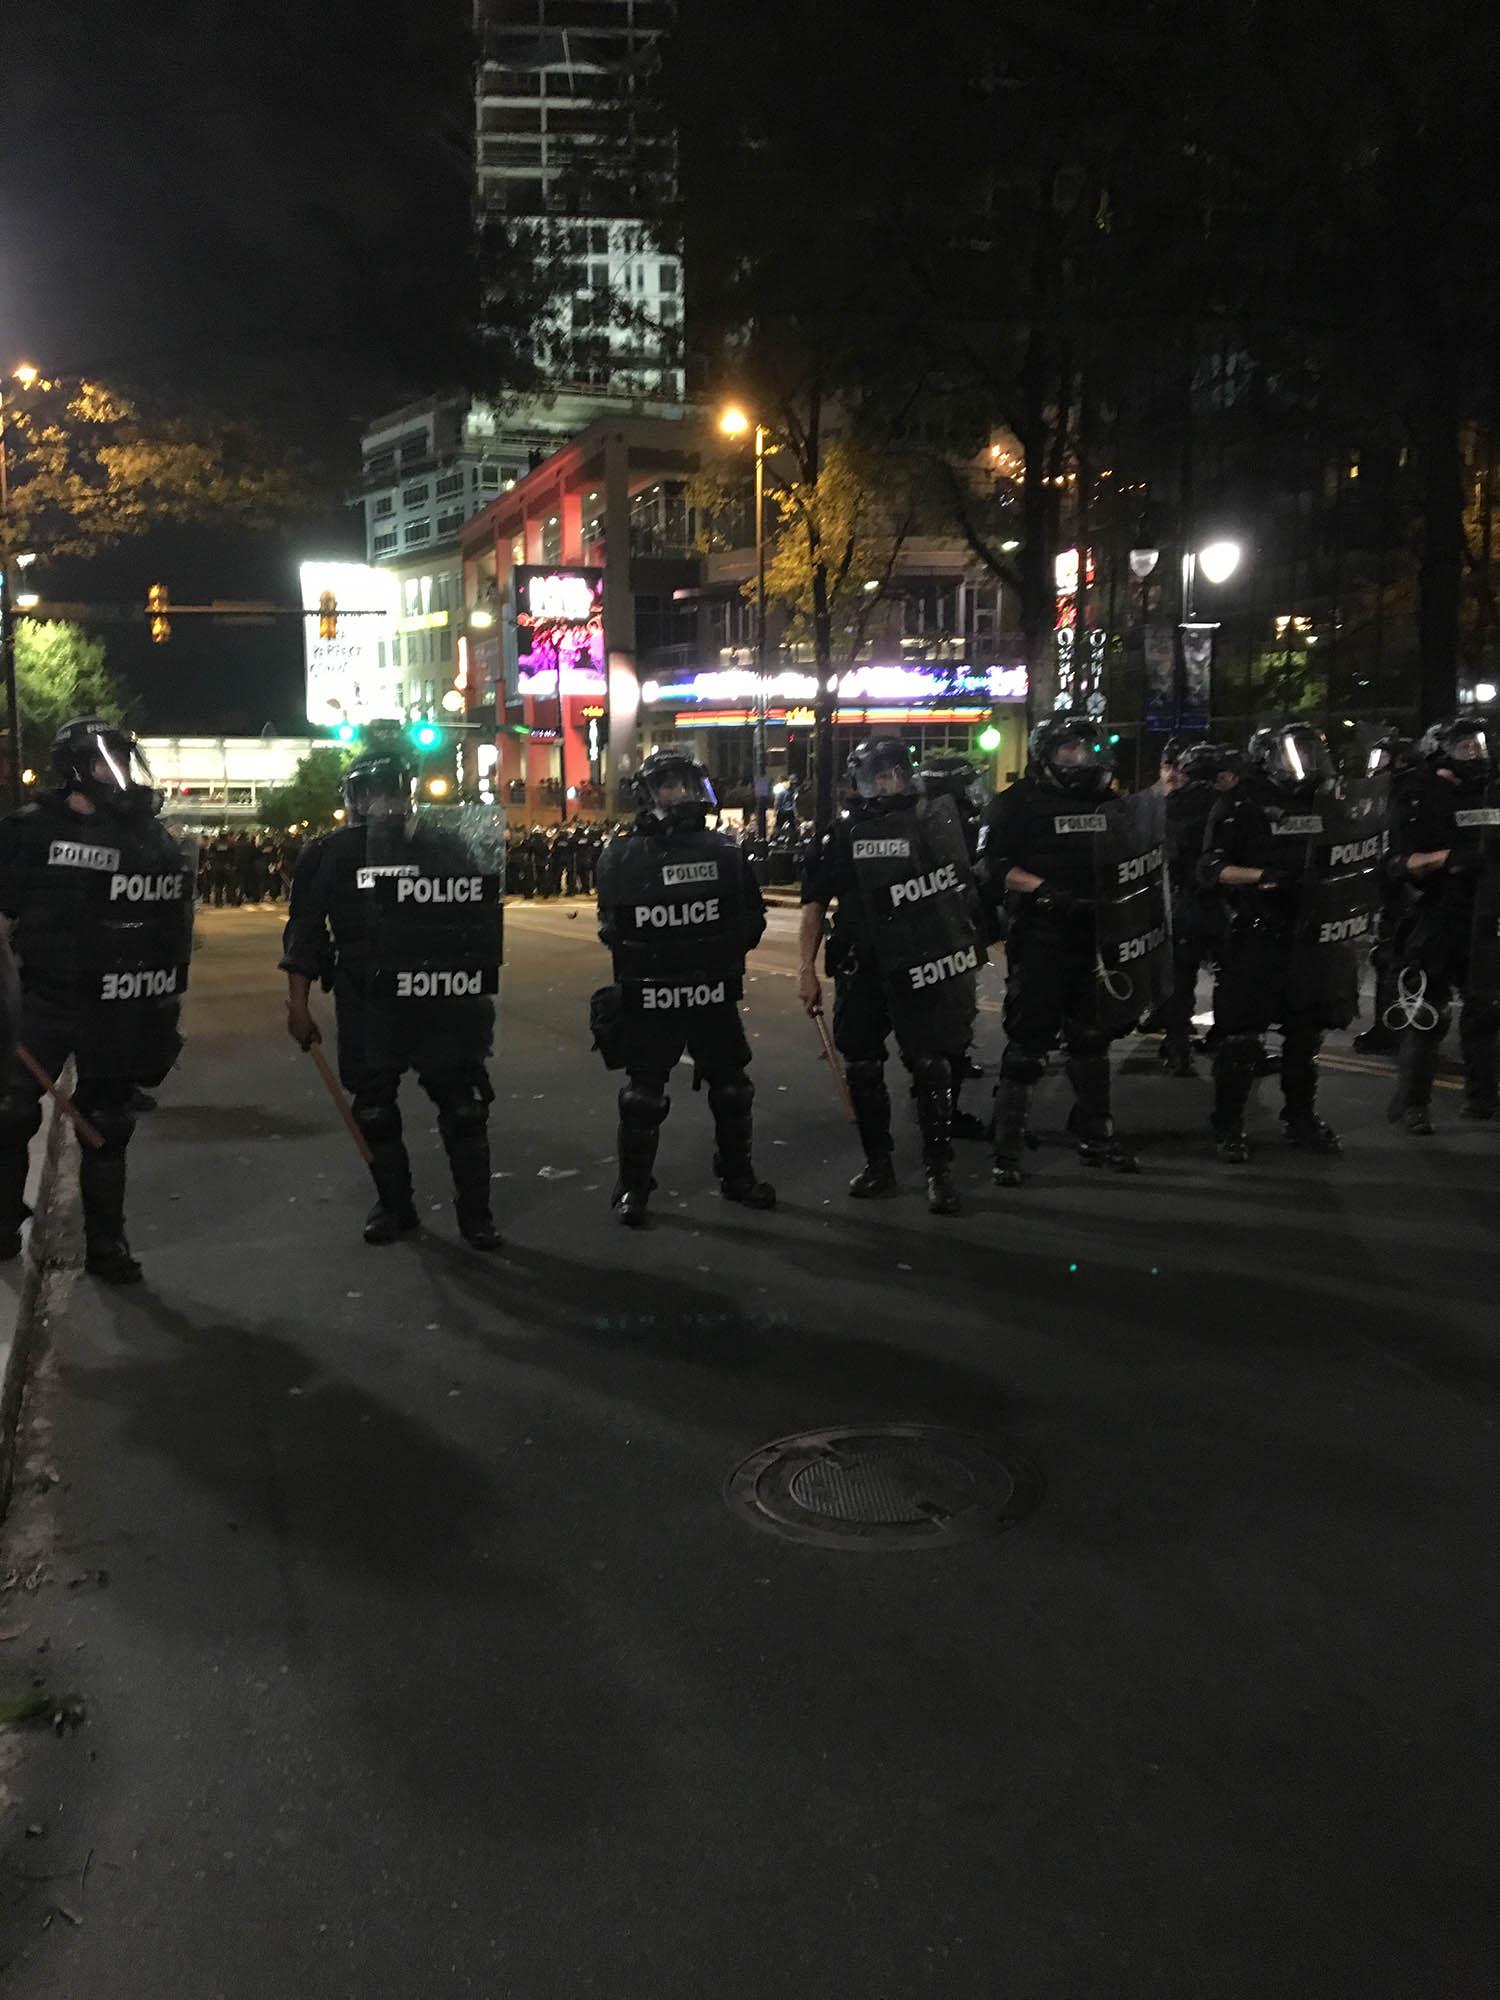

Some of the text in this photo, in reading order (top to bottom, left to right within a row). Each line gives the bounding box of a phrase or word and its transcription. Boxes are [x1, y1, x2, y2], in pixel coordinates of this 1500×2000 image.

[1058, 816, 1106, 833] POLICE
[53, 846, 114, 865] POLICE
[856, 842, 908, 856] POLICE
[666, 865, 717, 881] POLICE
[889, 863, 960, 908] POLICE
[109, 873, 184, 902] POLICE
[396, 876, 484, 903] POLICE
[634, 897, 721, 928] POLICE
[908, 944, 978, 990] POLICE
[99, 965, 178, 1001] POLICE
[396, 969, 484, 997] POLICE
[640, 980, 726, 1009] POLICE
